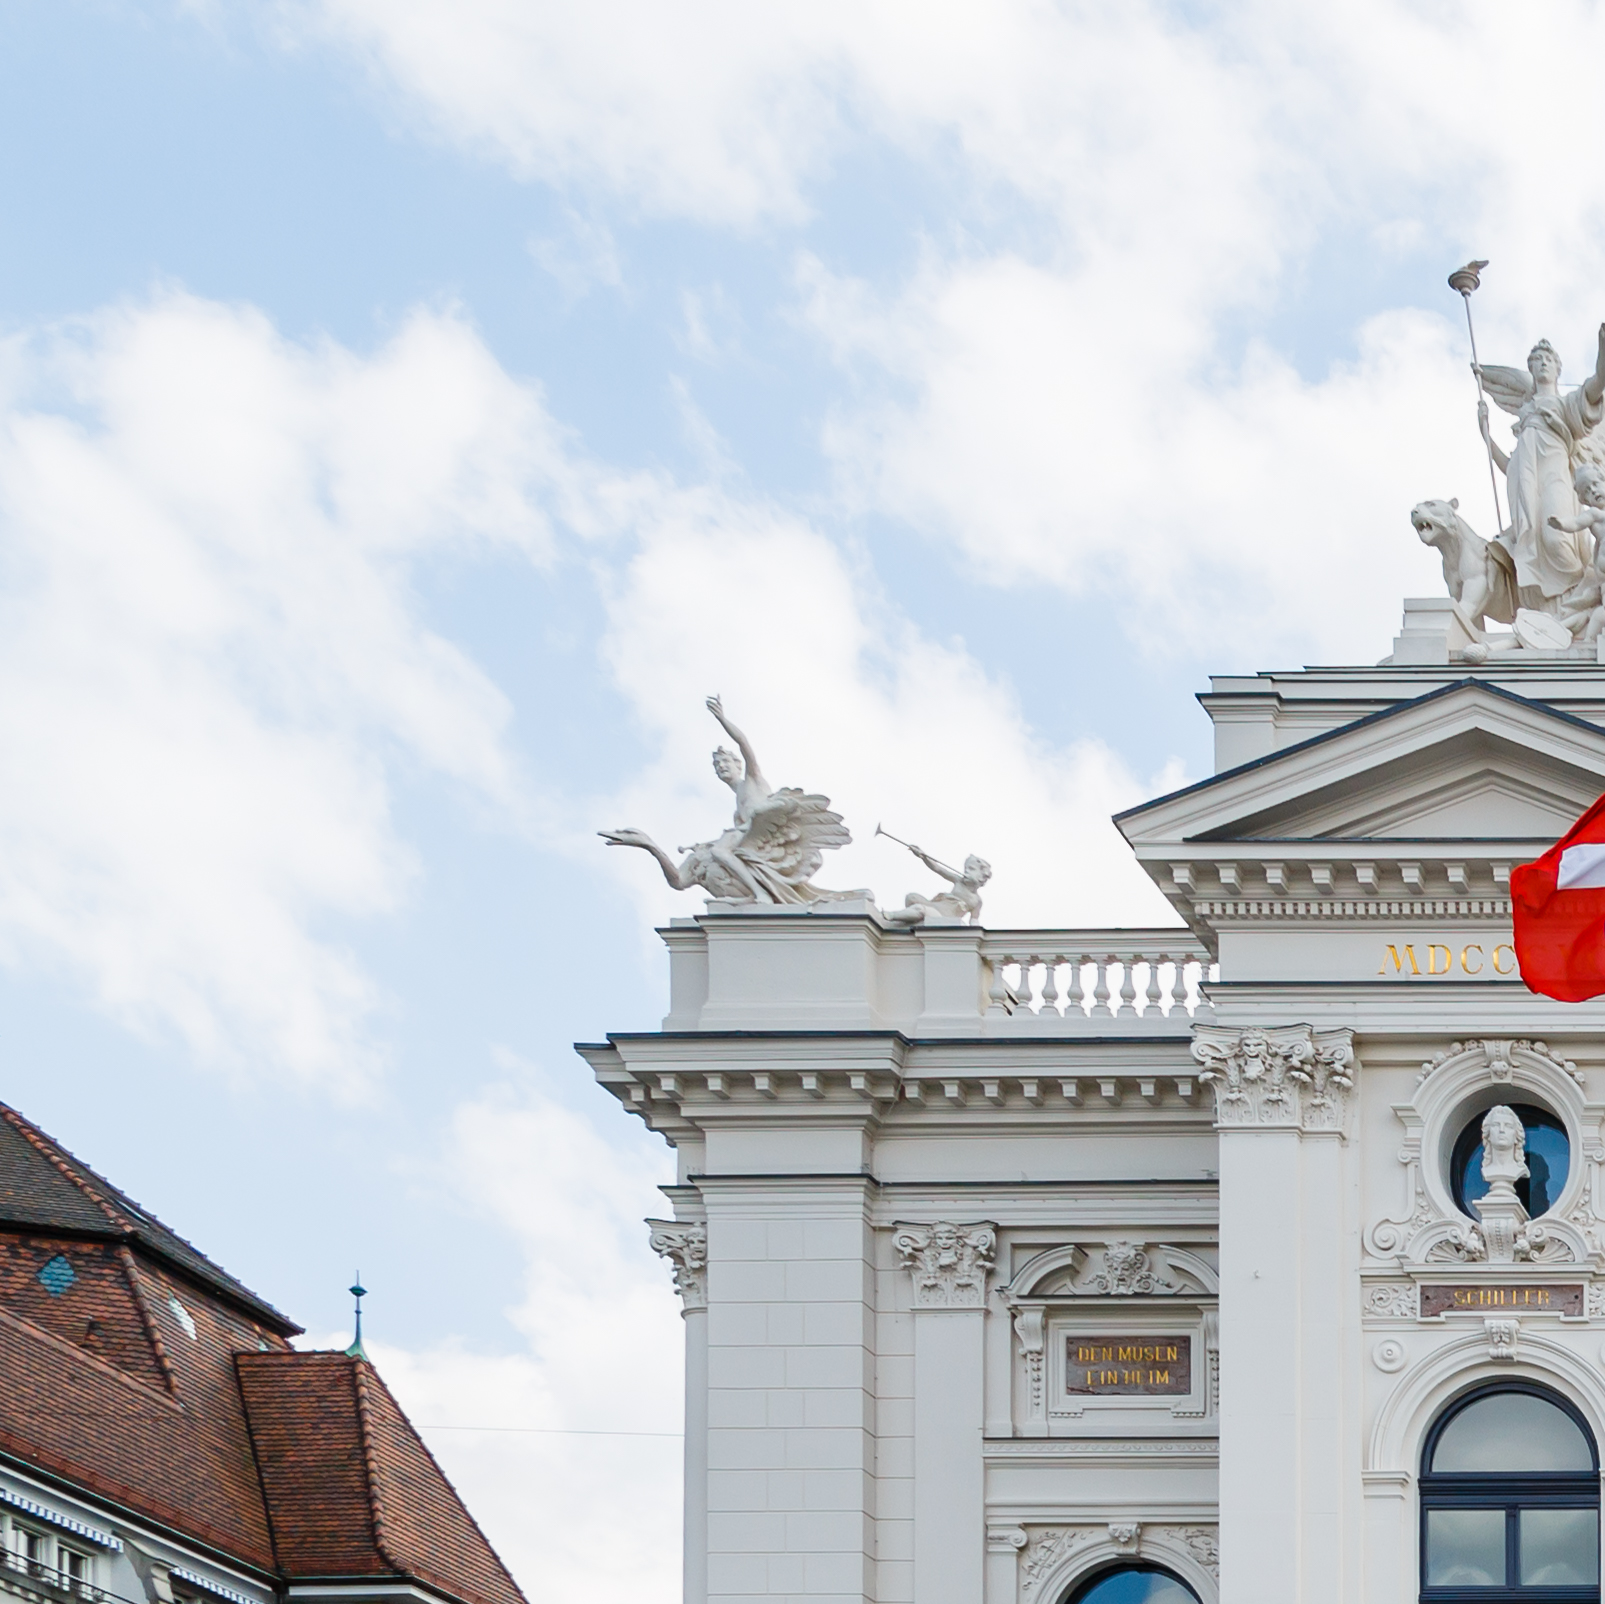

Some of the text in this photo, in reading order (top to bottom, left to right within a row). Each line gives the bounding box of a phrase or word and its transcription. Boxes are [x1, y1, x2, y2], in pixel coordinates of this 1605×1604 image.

[1453, 1289, 1550, 1306] SCHILLER
[1078, 1346, 1178, 1362] DEN MUSEN
[1086, 1370, 1170, 1385] EIN HEIM
